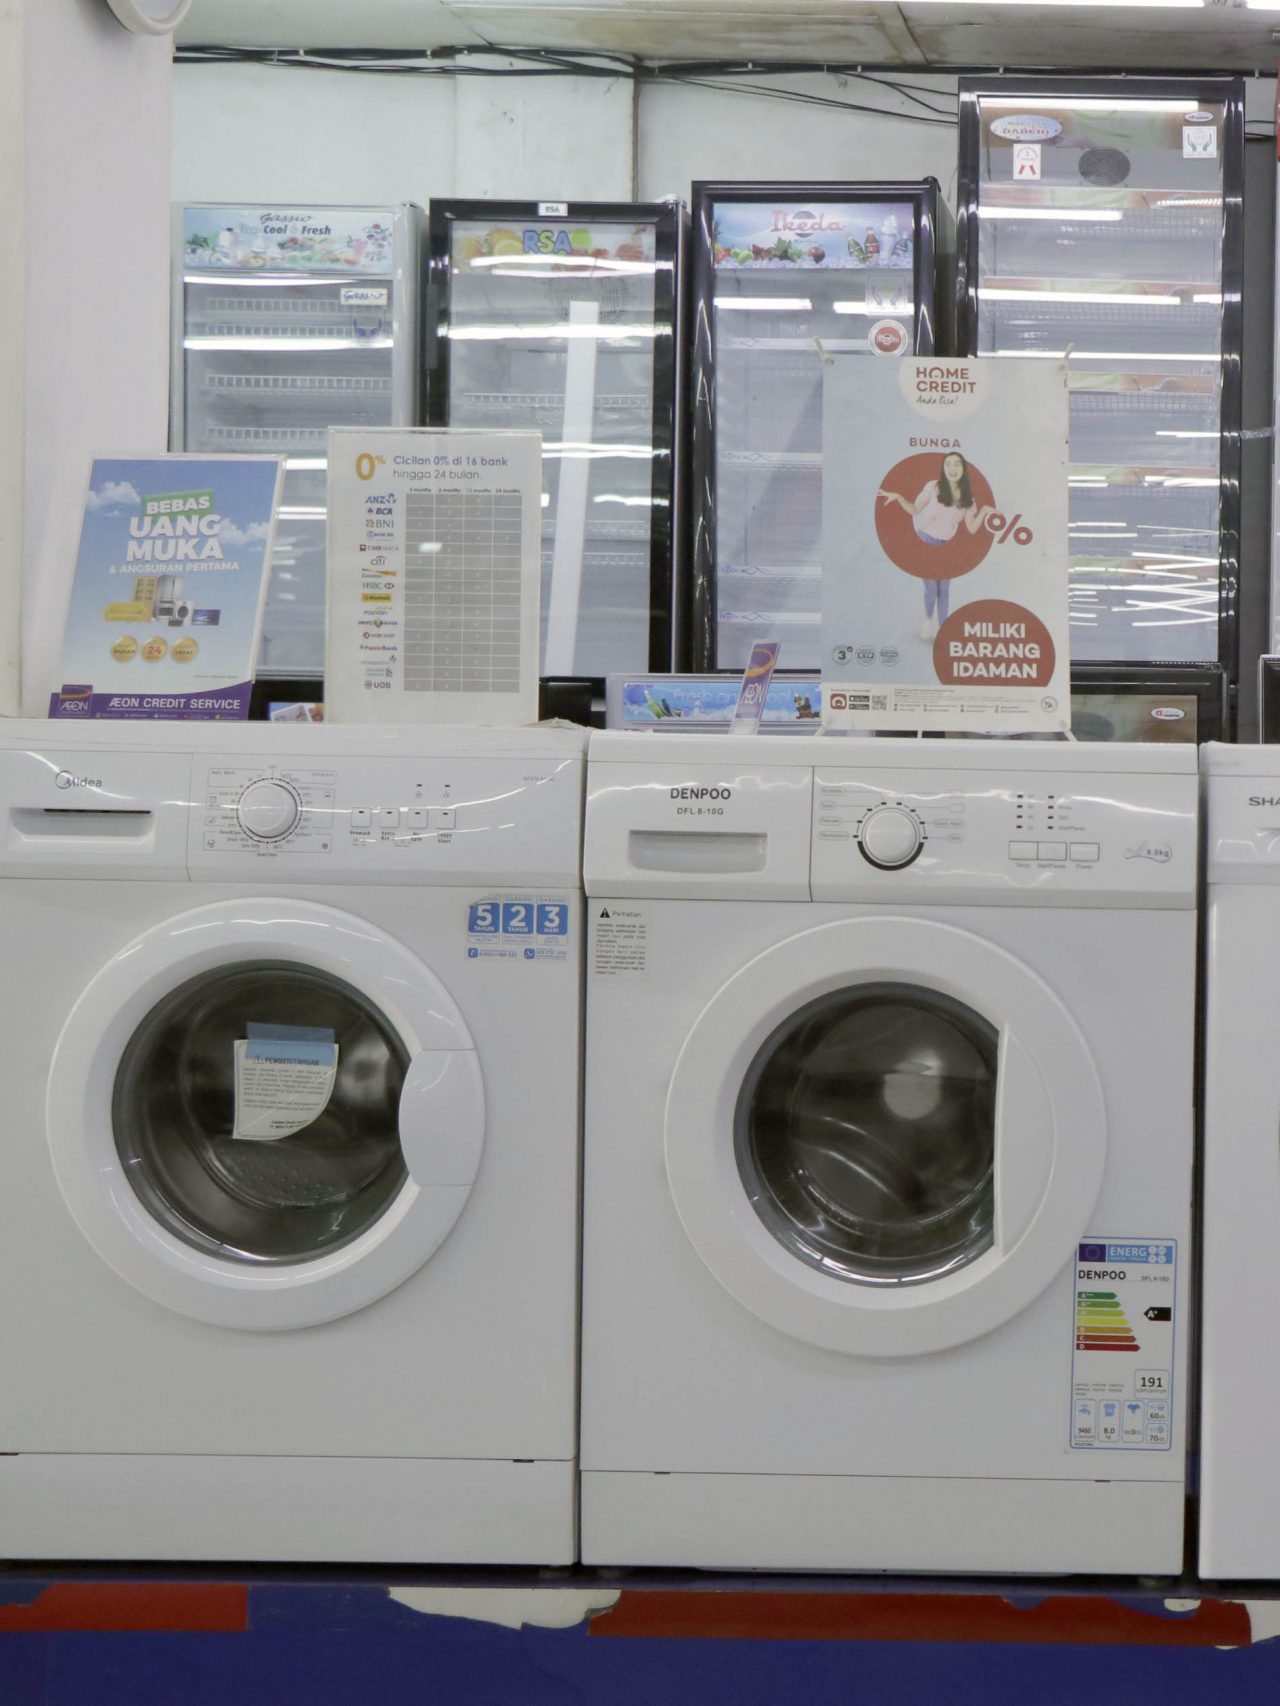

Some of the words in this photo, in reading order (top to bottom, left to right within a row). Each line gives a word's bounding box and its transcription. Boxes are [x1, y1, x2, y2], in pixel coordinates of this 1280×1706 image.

[263, 225, 288, 235] Cool
[301, 225, 332, 236] Fresh
[522, 229, 573, 255] RSA
[916, 366, 970, 380] HOME
[916, 380, 977, 394] CREDIT
[909, 437, 962, 449] BUNGA
[393, 455, 431, 466] Cicilan
[433, 455, 449, 466] 0%
[452, 455, 462, 466] di
[466, 456, 477, 466] 16
[480, 456, 508, 466] bank
[393, 469, 432, 481] hingga
[434, 470, 446, 479] 24
[449, 469, 483, 480] bulan.
[146, 495, 211, 515] BEBAS
[129, 514, 222, 538] UANG
[375, 520, 394, 529] BNI
[126, 537, 224, 561] MUKA
[119, 563, 183, 574] ANGSURAN
[186, 561, 240, 572] PERTAMA
[963, 621, 1026, 640] MILIKI
[949, 641, 1041, 660] BARANG
[952, 662, 1038, 680] IDAMAN
[374, 681, 391, 689] UOB
[143, 698, 187, 708] CREDIT
[190, 699, 241, 710] SERVICE
[55, 770, 103, 790] Midea
[670, 788, 731, 800] DENPOO
[677, 807, 695, 815] DFL
[476, 905, 493, 927] 5
[510, 905, 526, 927] 2
[543, 906, 560, 928] 3
[264, 1056, 320, 1066] PEMBERITAHUAN
[1109, 1246, 1148, 1257] ENERG
[1078, 1270, 1127, 1281] DENPOO
[1147, 1310, 1158, 1319] A+
[1140, 1376, 1163, 1388] 191
